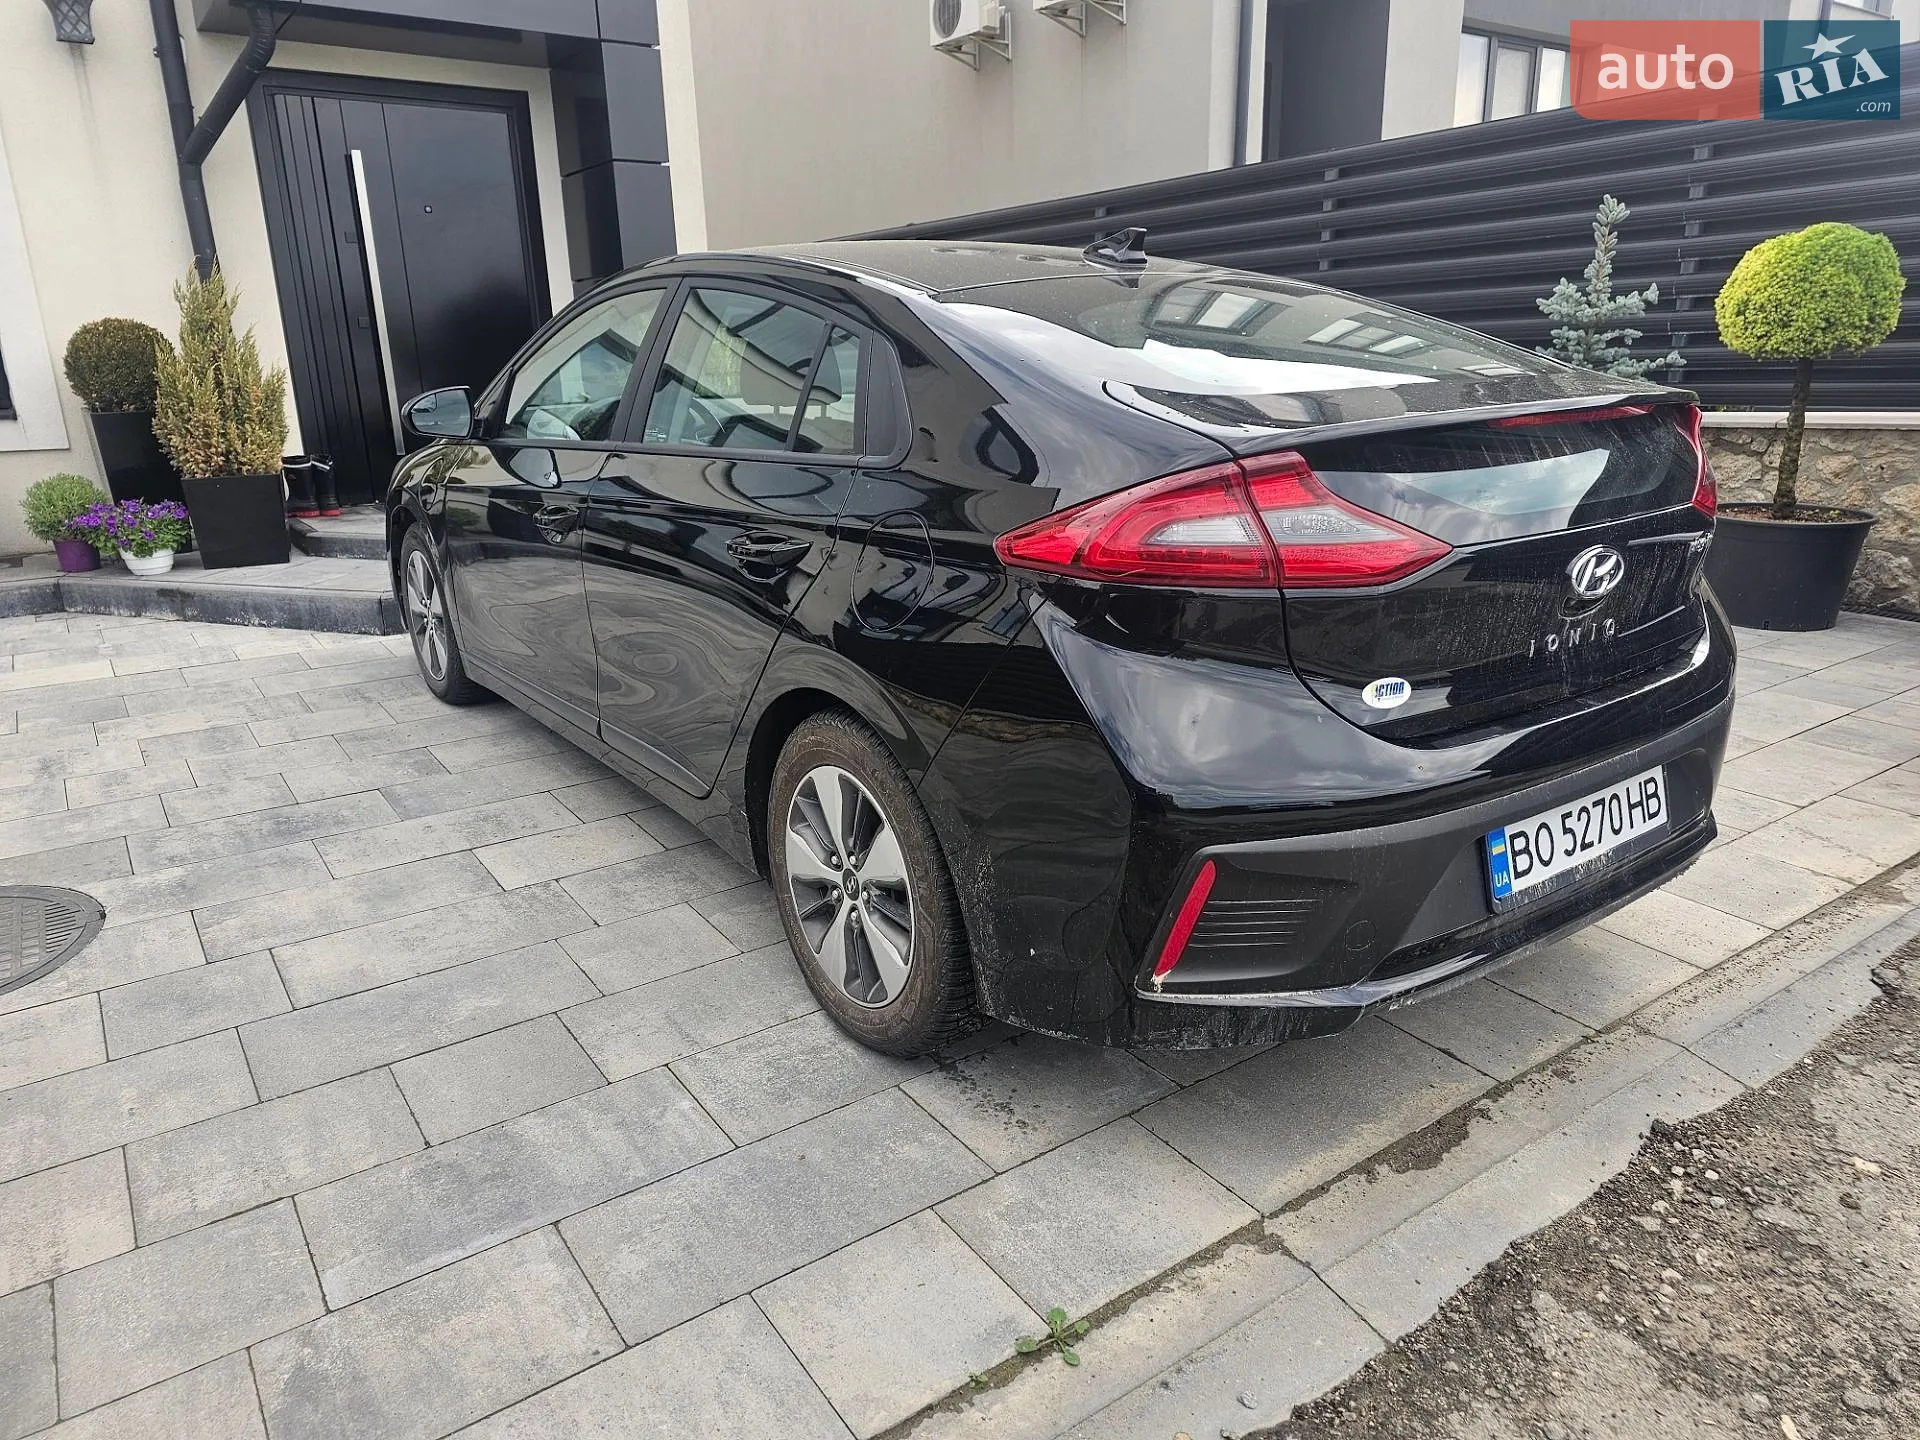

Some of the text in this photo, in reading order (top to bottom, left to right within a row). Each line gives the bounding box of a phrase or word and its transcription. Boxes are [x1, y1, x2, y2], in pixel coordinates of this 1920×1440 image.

[1528, 618, 1615, 658] IONIQ
[1508, 776, 1662, 881] BO 5270 HB
[1494, 872, 1510, 888] UA
